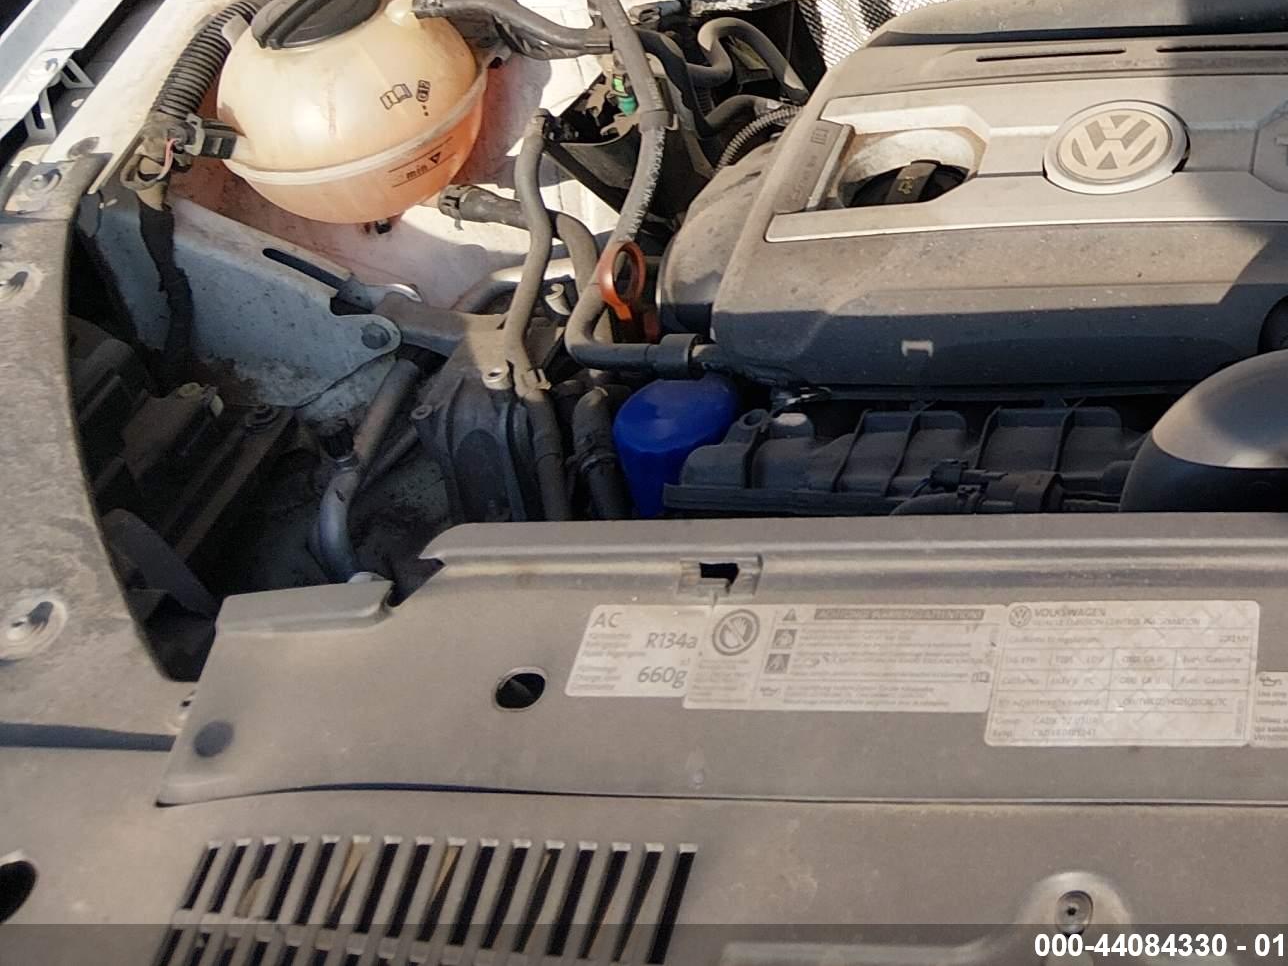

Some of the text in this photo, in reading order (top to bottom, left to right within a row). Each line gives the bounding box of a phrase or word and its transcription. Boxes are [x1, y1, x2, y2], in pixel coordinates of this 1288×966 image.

[406, 163, 429, 180] min
[591, 612, 623, 628] AC
[1034, 607, 1106, 617] VOLKSWAGEN
[645, 632, 698, 649] R134a
[637, 666, 688, 689] 660g
